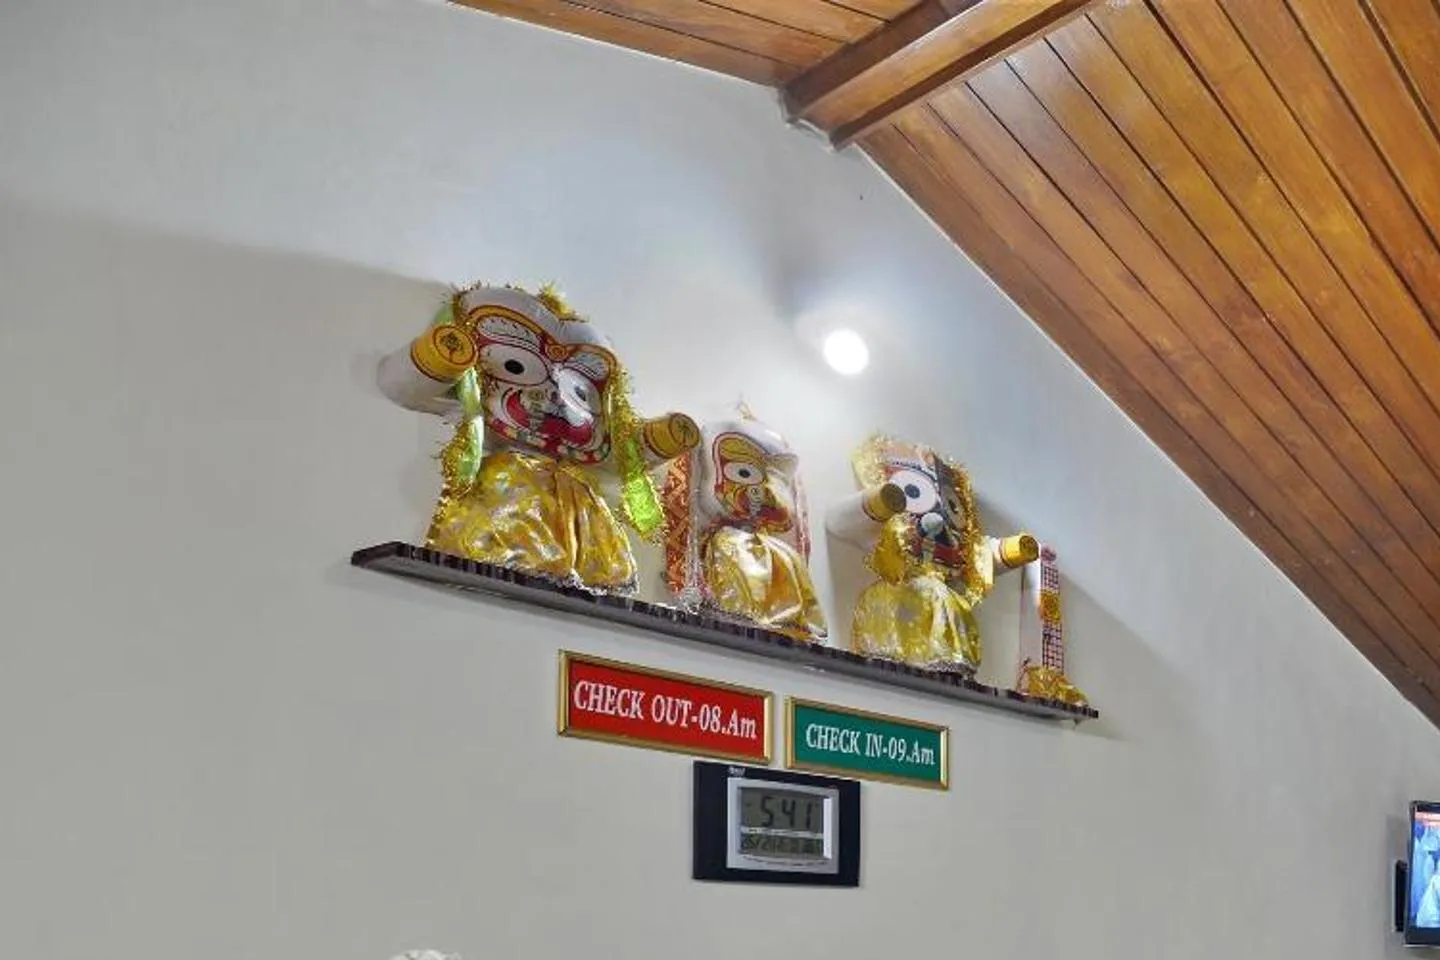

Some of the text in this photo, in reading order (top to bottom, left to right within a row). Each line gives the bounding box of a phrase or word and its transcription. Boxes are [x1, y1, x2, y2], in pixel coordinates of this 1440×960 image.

[574, 681, 757, 739] CHECK OUT-08.Am
[806, 723, 936, 765] CHECK IN-09.Am
